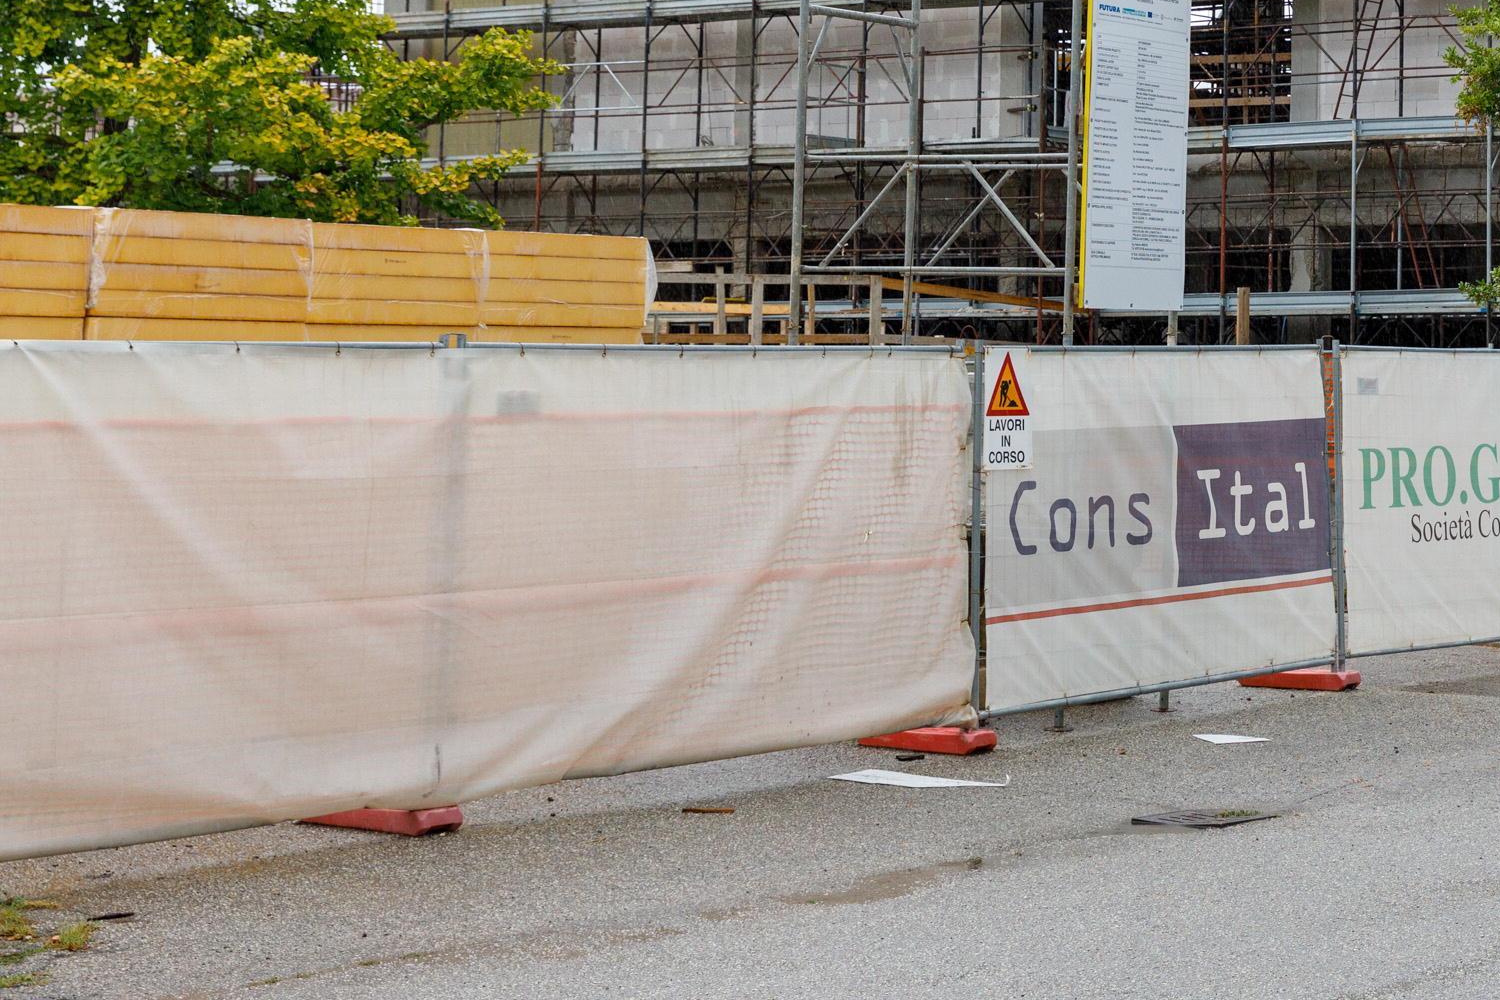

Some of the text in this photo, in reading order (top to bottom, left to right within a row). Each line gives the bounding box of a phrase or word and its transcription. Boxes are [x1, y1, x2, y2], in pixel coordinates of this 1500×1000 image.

[1099, 3, 1121, 13] FUTURA
[989, 419, 1025, 431] LAVORI
[1001, 435, 1011, 447] IN
[988, 451, 1025, 463] CORSO
[1009, 462, 1316, 556] Cons Ital
[1411, 510, 1473, 543] Società
